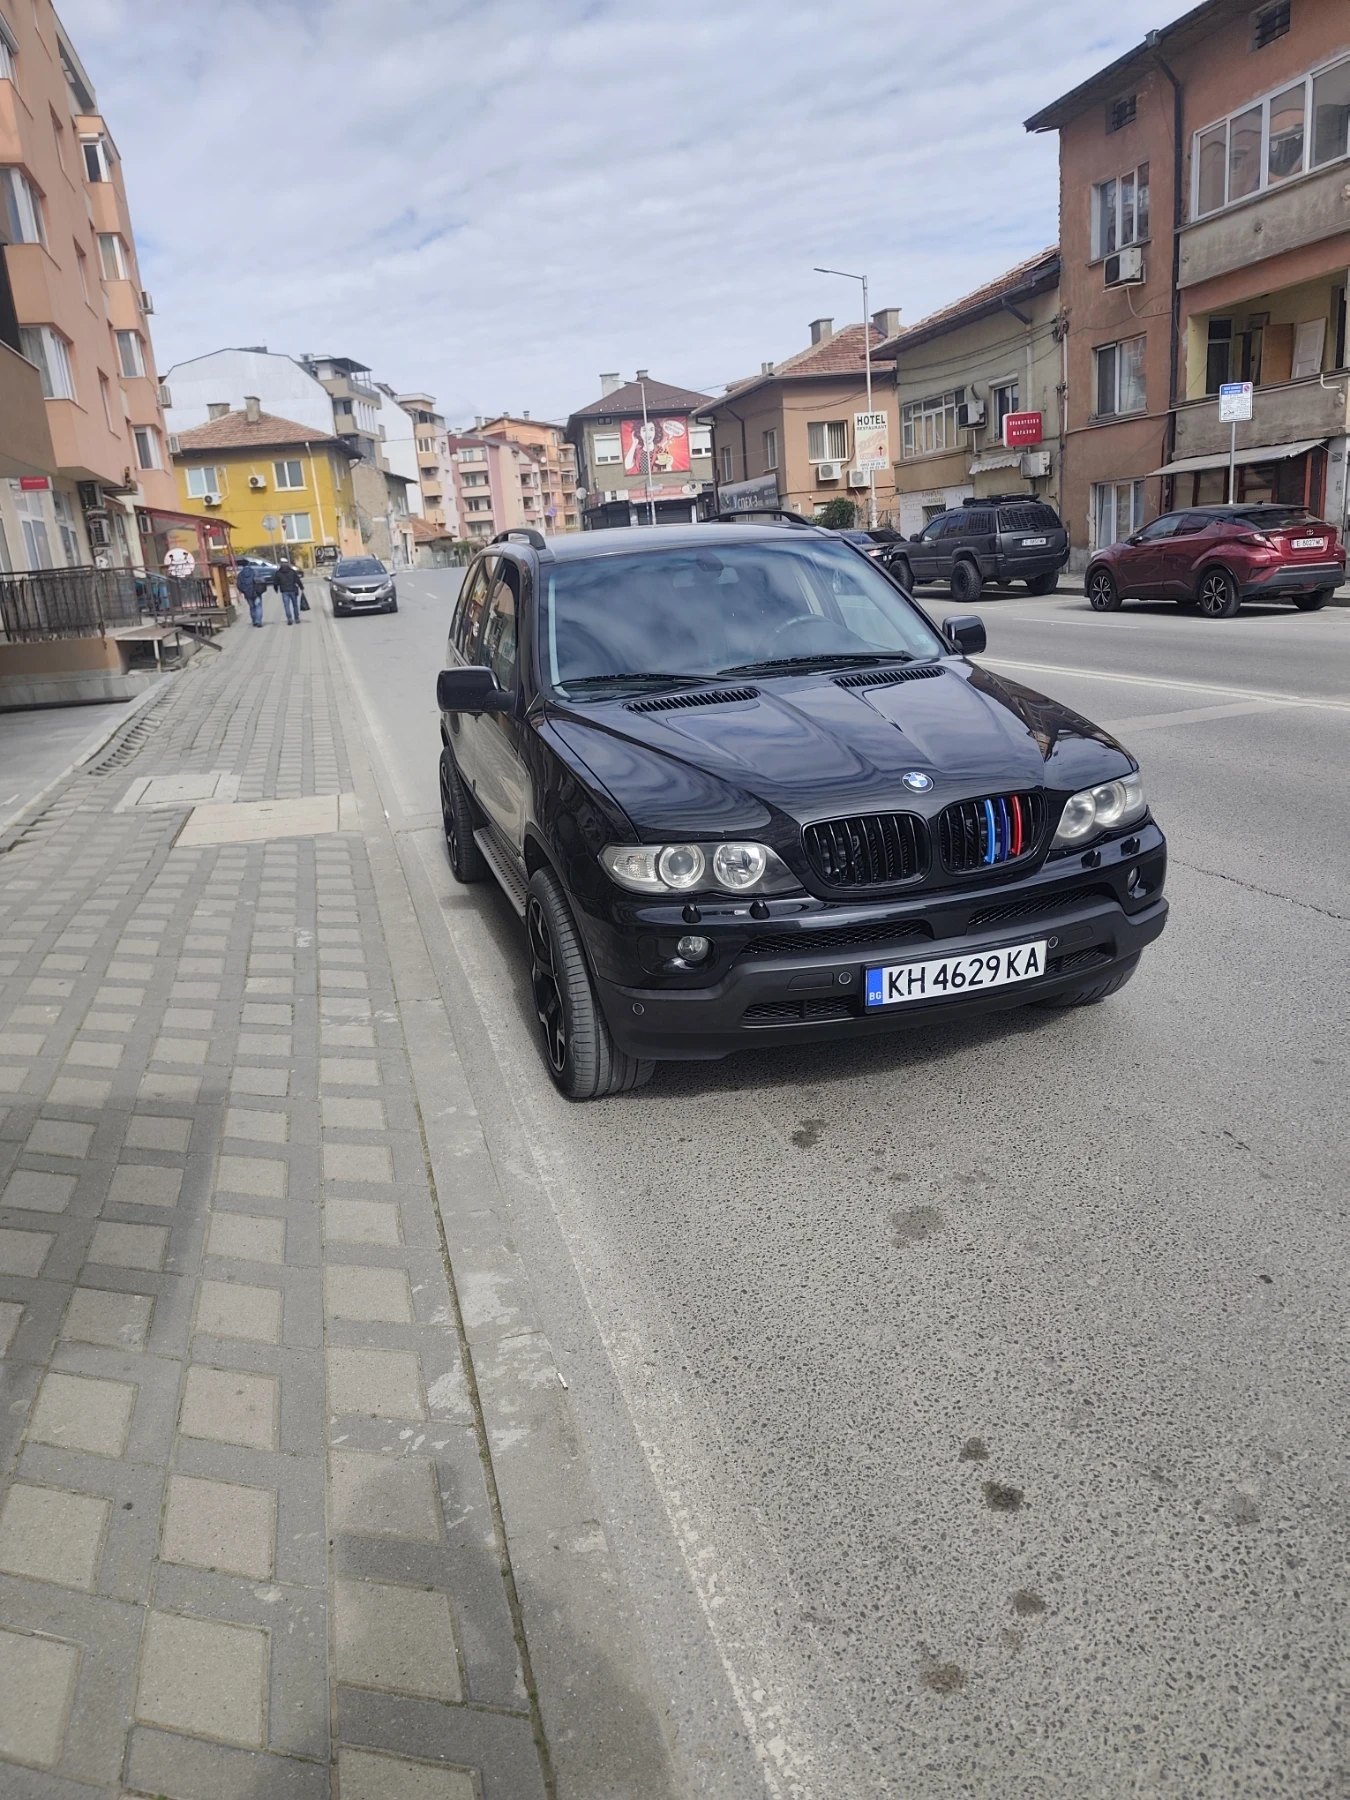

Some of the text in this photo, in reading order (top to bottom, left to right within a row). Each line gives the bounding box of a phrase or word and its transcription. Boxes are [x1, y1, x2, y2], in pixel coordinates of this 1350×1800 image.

[857, 414, 886, 426] HOTEL
[869, 947, 1039, 1001] BG KH 4629 KA
